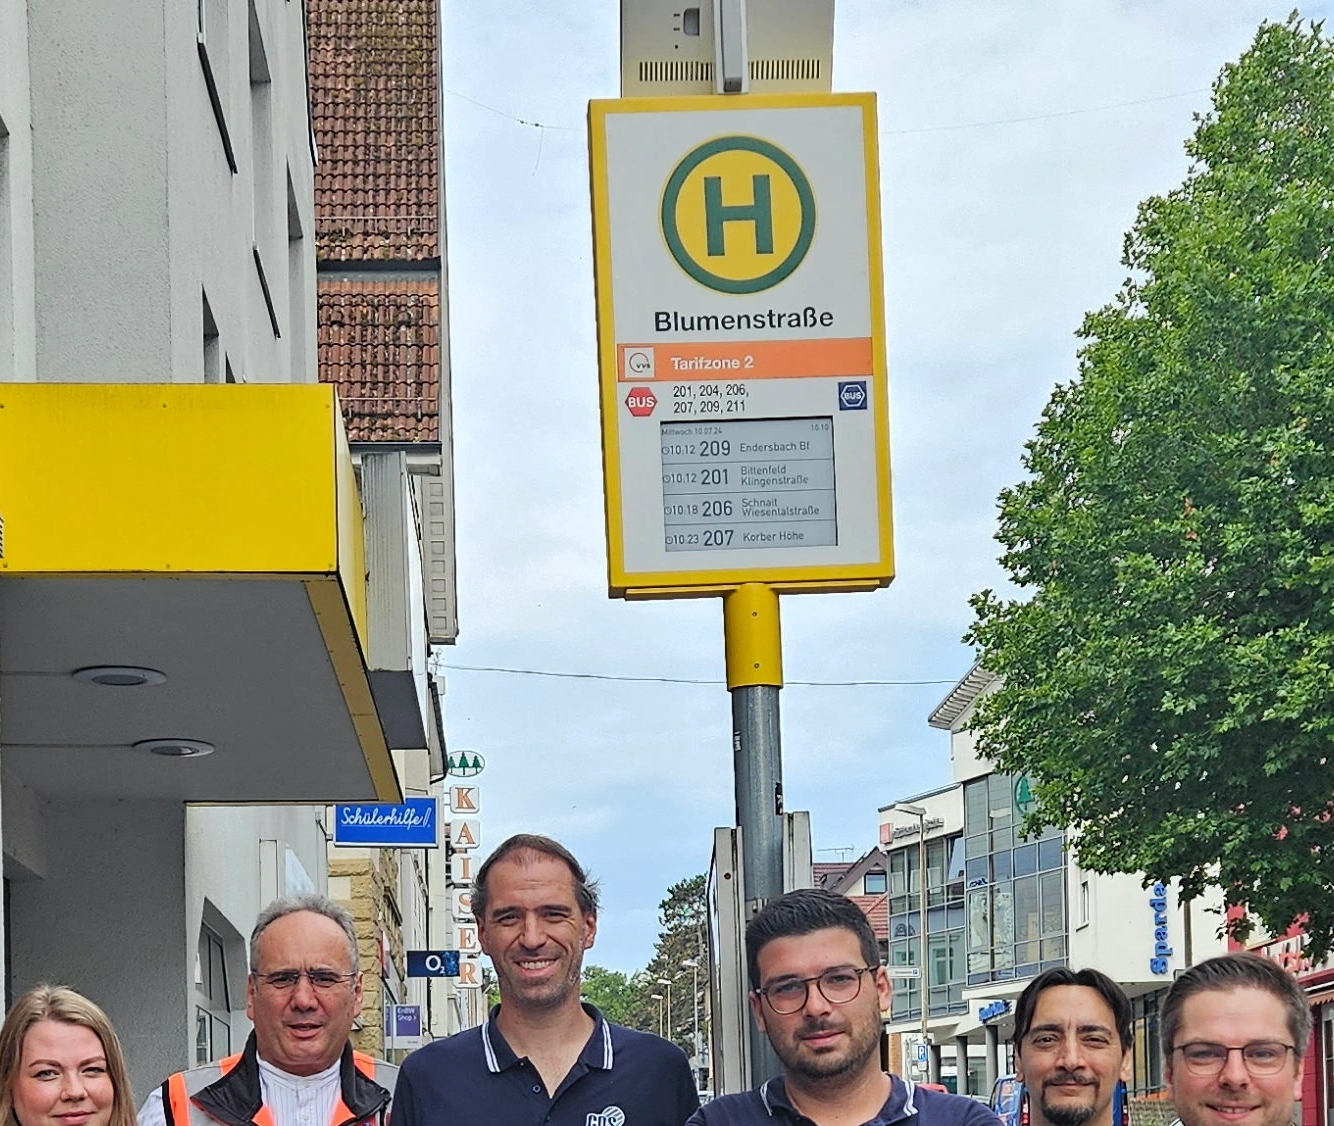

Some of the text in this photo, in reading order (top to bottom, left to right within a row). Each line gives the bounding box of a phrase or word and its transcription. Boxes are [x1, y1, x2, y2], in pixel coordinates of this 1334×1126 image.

[704, 175, 773, 256] H
[654, 306, 834, 333] Blumenstraße
[671, 355, 754, 371] Tarifzone 2
[673, 384, 749, 399] 201, 204, 206,
[844, 391, 862, 400] BUS
[628, 397, 655, 408] BUS
[673, 400, 746, 415] 207, 209, 211
[661, 428, 693, 436] Mittwoch
[700, 440, 731, 456] 209
[740, 442, 797, 453] Endersbach
[799, 441, 810, 451] Bf
[701, 469, 729, 485] 201
[740, 466, 786, 475] Bittenfeld
[741, 475, 809, 487] Klingenstraße
[702, 500, 733, 517] 206
[742, 498, 777, 508] Schnait
[742, 506, 820, 517] Wiesentalstraße
[703, 530, 734, 546] 207
[743, 532, 776, 542] Korber
[779, 531, 804, 541] Höhe
[455, 787, 479, 984] KAISER
[1149, 883, 1173, 975] Sparda
[397, 1014, 413, 1022] Shop
